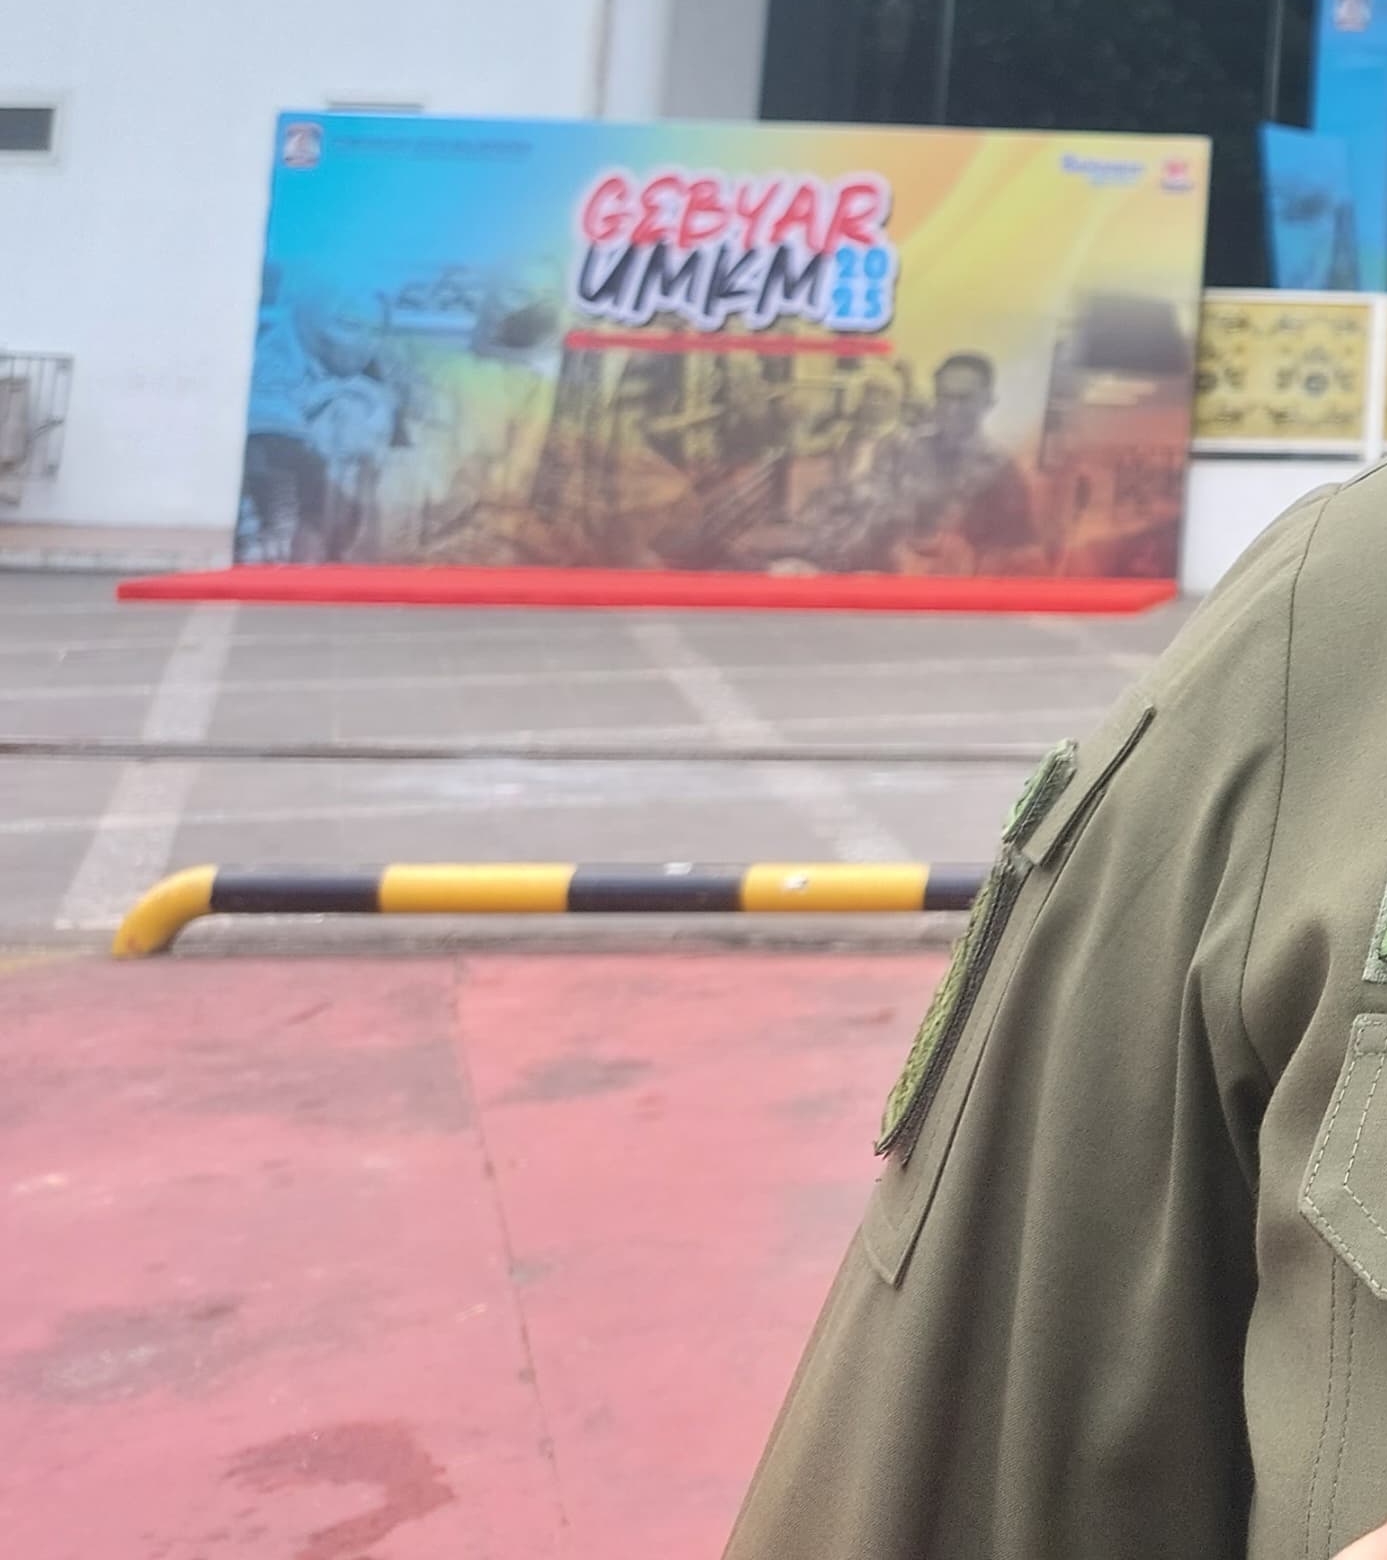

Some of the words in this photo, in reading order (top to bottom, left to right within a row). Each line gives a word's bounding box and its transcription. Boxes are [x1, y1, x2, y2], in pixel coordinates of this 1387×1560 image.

[583, 175, 881, 254] GEBYAR
[577, 240, 827, 317] UMKM
[835, 246, 889, 279] 20
